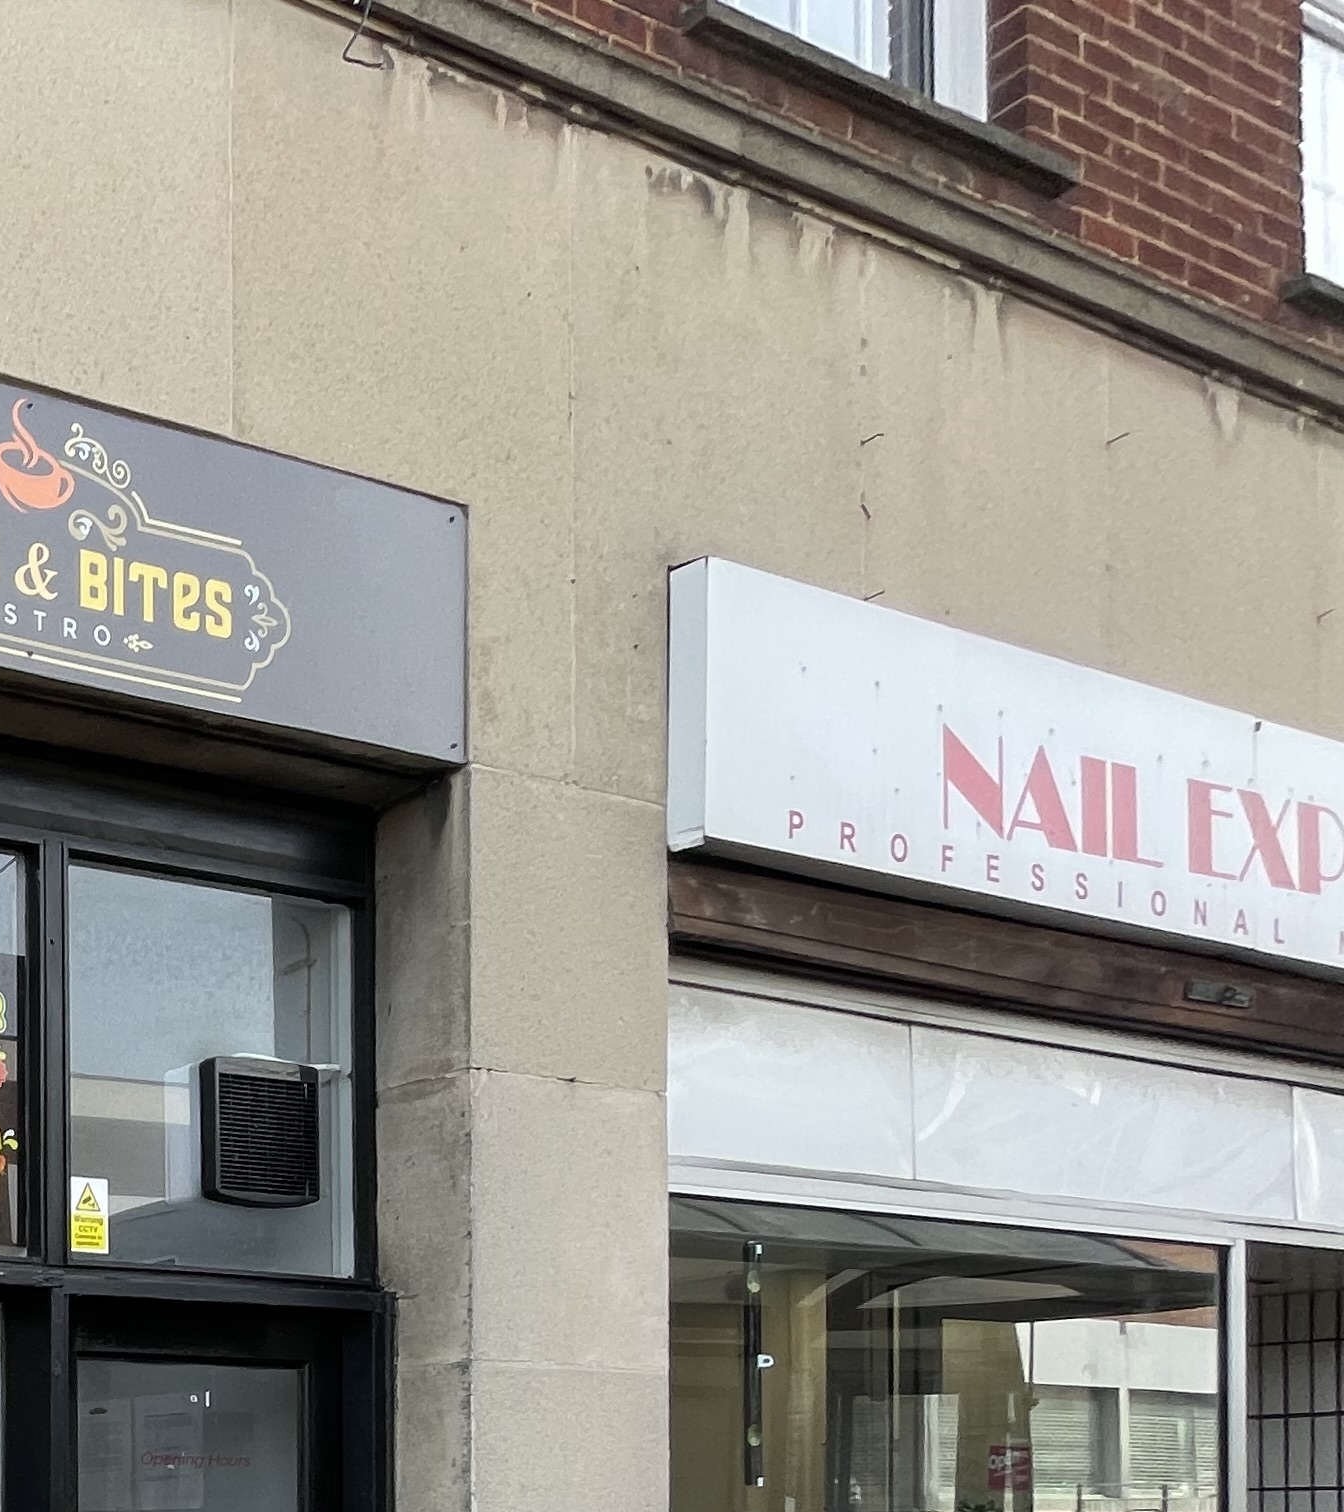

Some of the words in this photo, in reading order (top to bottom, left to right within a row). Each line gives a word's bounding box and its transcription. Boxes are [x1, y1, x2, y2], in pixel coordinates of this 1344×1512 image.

[14, 542, 59, 600] &
[942, 722, 1164, 869] NAIL
[787, 809, 1286, 946] PROFESSIONAL
[78, 1225, 99, 1233] CCTV
[141, 1451, 204, 1469] Opening
[208, 1454, 252, 1468] Hours
